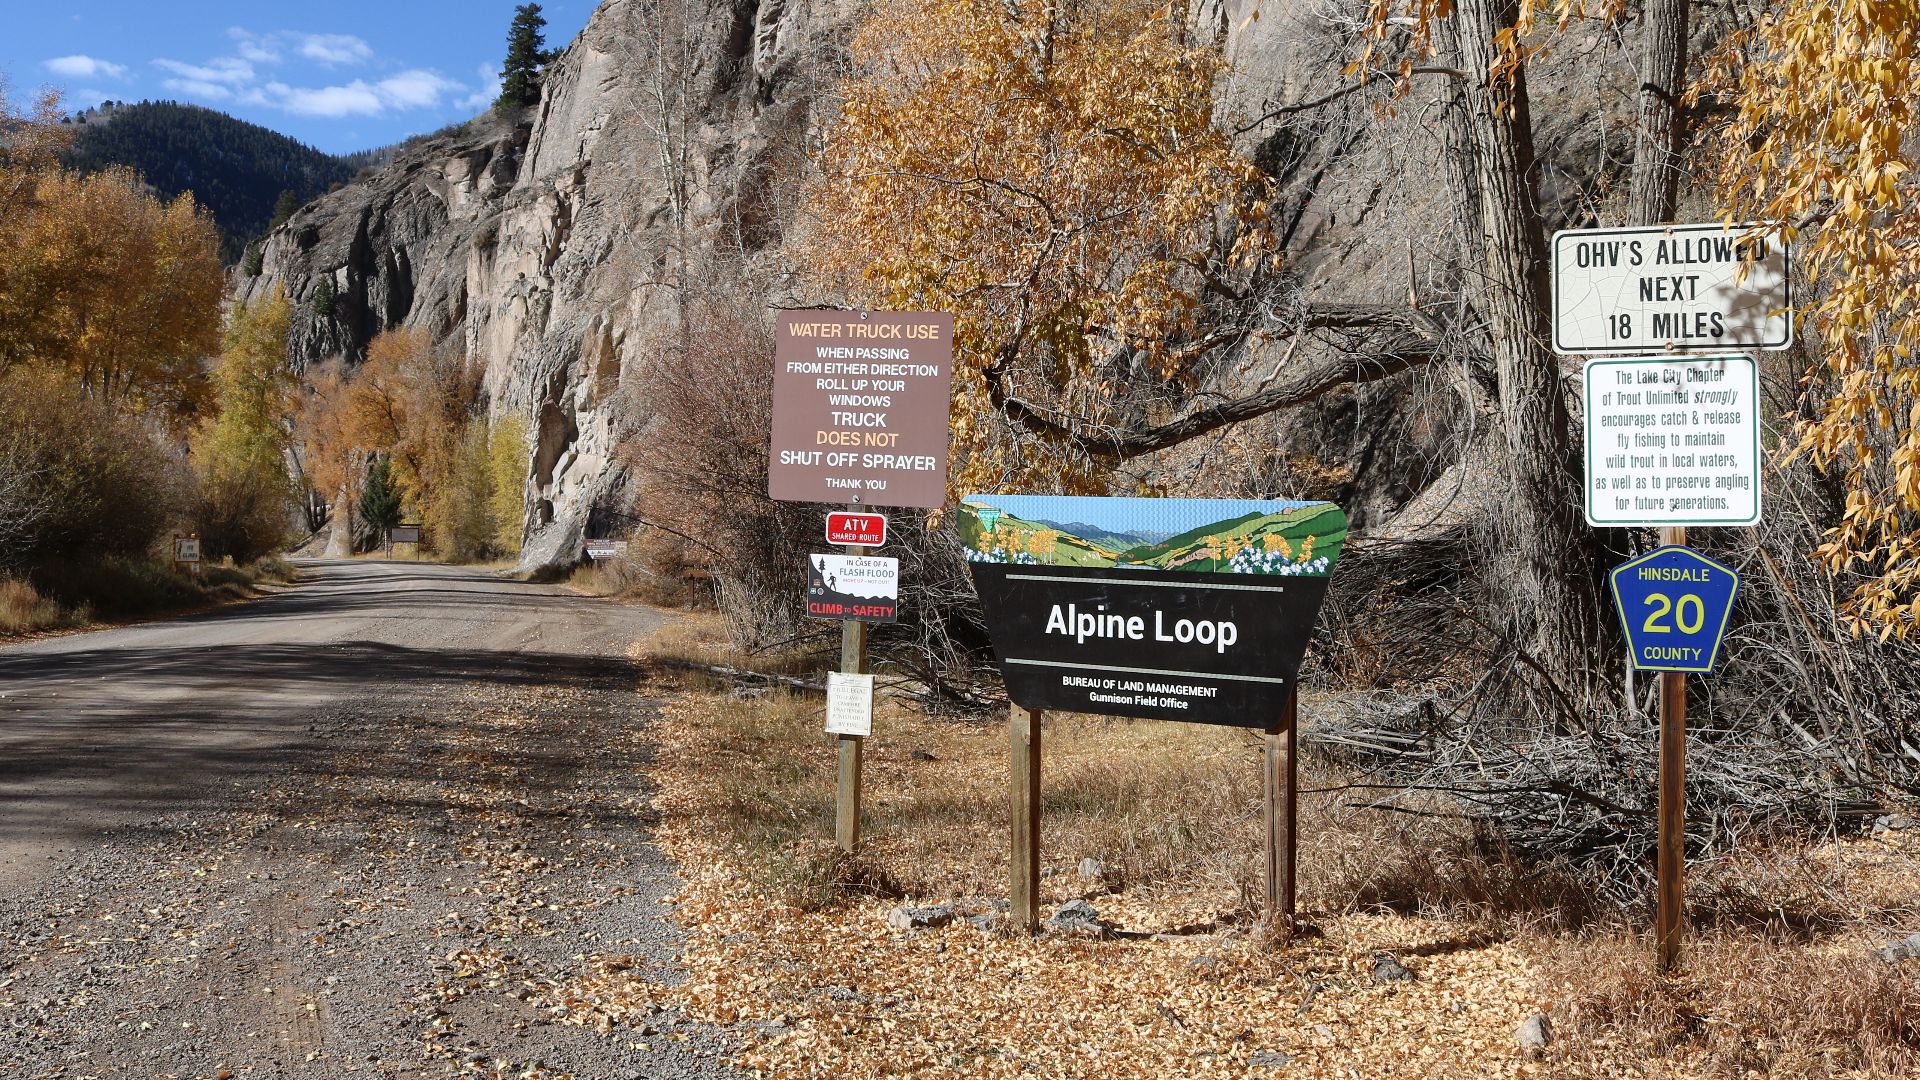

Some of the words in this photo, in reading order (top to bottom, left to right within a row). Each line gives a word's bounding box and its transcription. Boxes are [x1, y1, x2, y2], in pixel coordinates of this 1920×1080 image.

[1576, 240, 1643, 268] OHV'S
[1639, 275, 1700, 302] NEXT
[789, 323, 841, 338] WATER
[846, 324, 902, 339] TRUCK
[906, 325, 940, 340] USE
[1609, 313, 1632, 340] 18
[1652, 311, 1724, 339] MILES
[816, 347, 854, 359] WHEN
[856, 349, 909, 360] PASSING
[787, 362, 822, 374] FROM
[824, 363, 868, 375] EITHER
[871, 364, 938, 377] DIRECTION
[1616, 371, 1632, 384] The
[1637, 370, 1658, 384] Lake
[1663, 369, 1681, 385] City
[1686, 367, 1725, 384] Chapter
[816, 379, 849, 390] ROLL
[852, 380, 868, 391] UP
[872, 380, 905, 392] YOUR
[829, 395, 891, 407] WINDOWS
[1602, 392, 1612, 406] of
[1617, 391, 1641, 405] Trout
[1646, 390, 1689, 405] Unlimited
[1694, 389, 1738, 405] strongly
[832, 412, 887, 428] TRUCK
[1601, 414, 1656, 428] encourages
[1661, 411, 1687, 425] catch
[1692, 410, 1699, 425] &
[1704, 410, 1741, 424] release
[816, 431, 861, 446] DOES
[865, 432, 899, 448] NOT
[1617, 433, 1630, 449] fly
[1635, 432, 1666, 449] fishing
[1671, 432, 1680, 446] to
[1685, 432, 1725, 446] maintain
[780, 451, 823, 466] SHUT
[826, 453, 859, 468] OFF
[862, 454, 936, 471] SPRAYER
[1606, 454, 1626, 468] wild
[1631, 454, 1655, 468] trout
[1659, 454, 1668, 468] in
[1672, 453, 1695, 468] local
[1700, 453, 1738, 469] waters,
[826, 478, 862, 489] THANK
[865, 480, 887, 490] YOU
[1595, 477, 1607, 490] as
[1612, 475, 1631, 489] well
[1635, 477, 1647, 489] as
[1652, 475, 1661, 489] to
[1666, 475, 1710, 491] preserve
[1715, 474, 1749, 490] angling
[1615, 497, 1630, 510] for
[1635, 496, 1665, 510] future
[1669, 495, 1730, 512] generations.
[844, 519, 868, 531] ATV
[859, 534, 879, 542] ROUTE
[855, 559, 872, 567] CASE
[873, 560, 882, 568] OF
[839, 567, 865, 577] FLASH
[867, 570, 894, 578] FLOOD
[1638, 568, 1710, 581] HINSDALE
[809, 603, 842, 614] CLIMB
[853, 606, 893, 617] SAFETY
[1642, 593, 1705, 634] 20
[1045, 604, 1145, 644] Alpine
[1155, 610, 1238, 653] Loop
[1643, 646, 1702, 660] COUNTY
[1062, 675, 1101, 688] BUREAU
[1102, 679, 1116, 690] OF
[1117, 680, 1144, 692] LAND
[1146, 682, 1218, 698] MANAGEMENT
[1089, 691, 1132, 705] Gunnison
[1134, 695, 1158, 707] Field
[1159, 697, 1189, 710] Office
